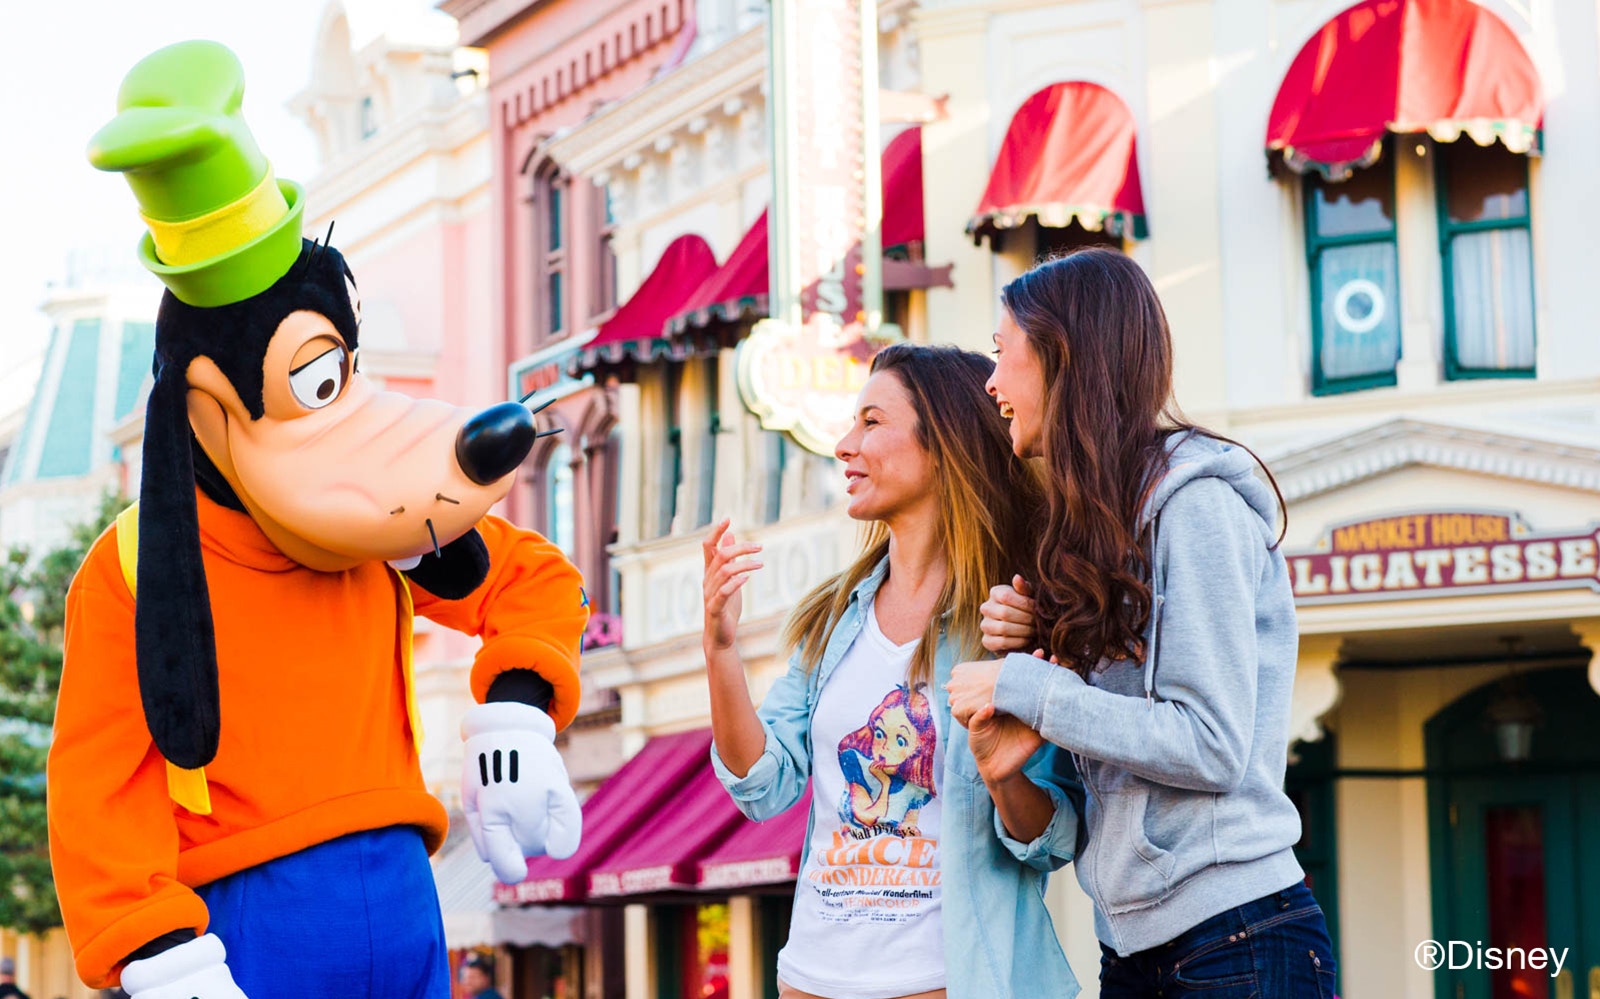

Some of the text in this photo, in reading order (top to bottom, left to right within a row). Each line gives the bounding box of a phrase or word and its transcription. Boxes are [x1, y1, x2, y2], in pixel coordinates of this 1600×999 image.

[1334, 513, 1506, 552] MARKET HOUSE
[1289, 534, 1600, 595] LICATESSE
[849, 826, 871, 841] Walt
[883, 889, 933, 899] Wonderfilm!
